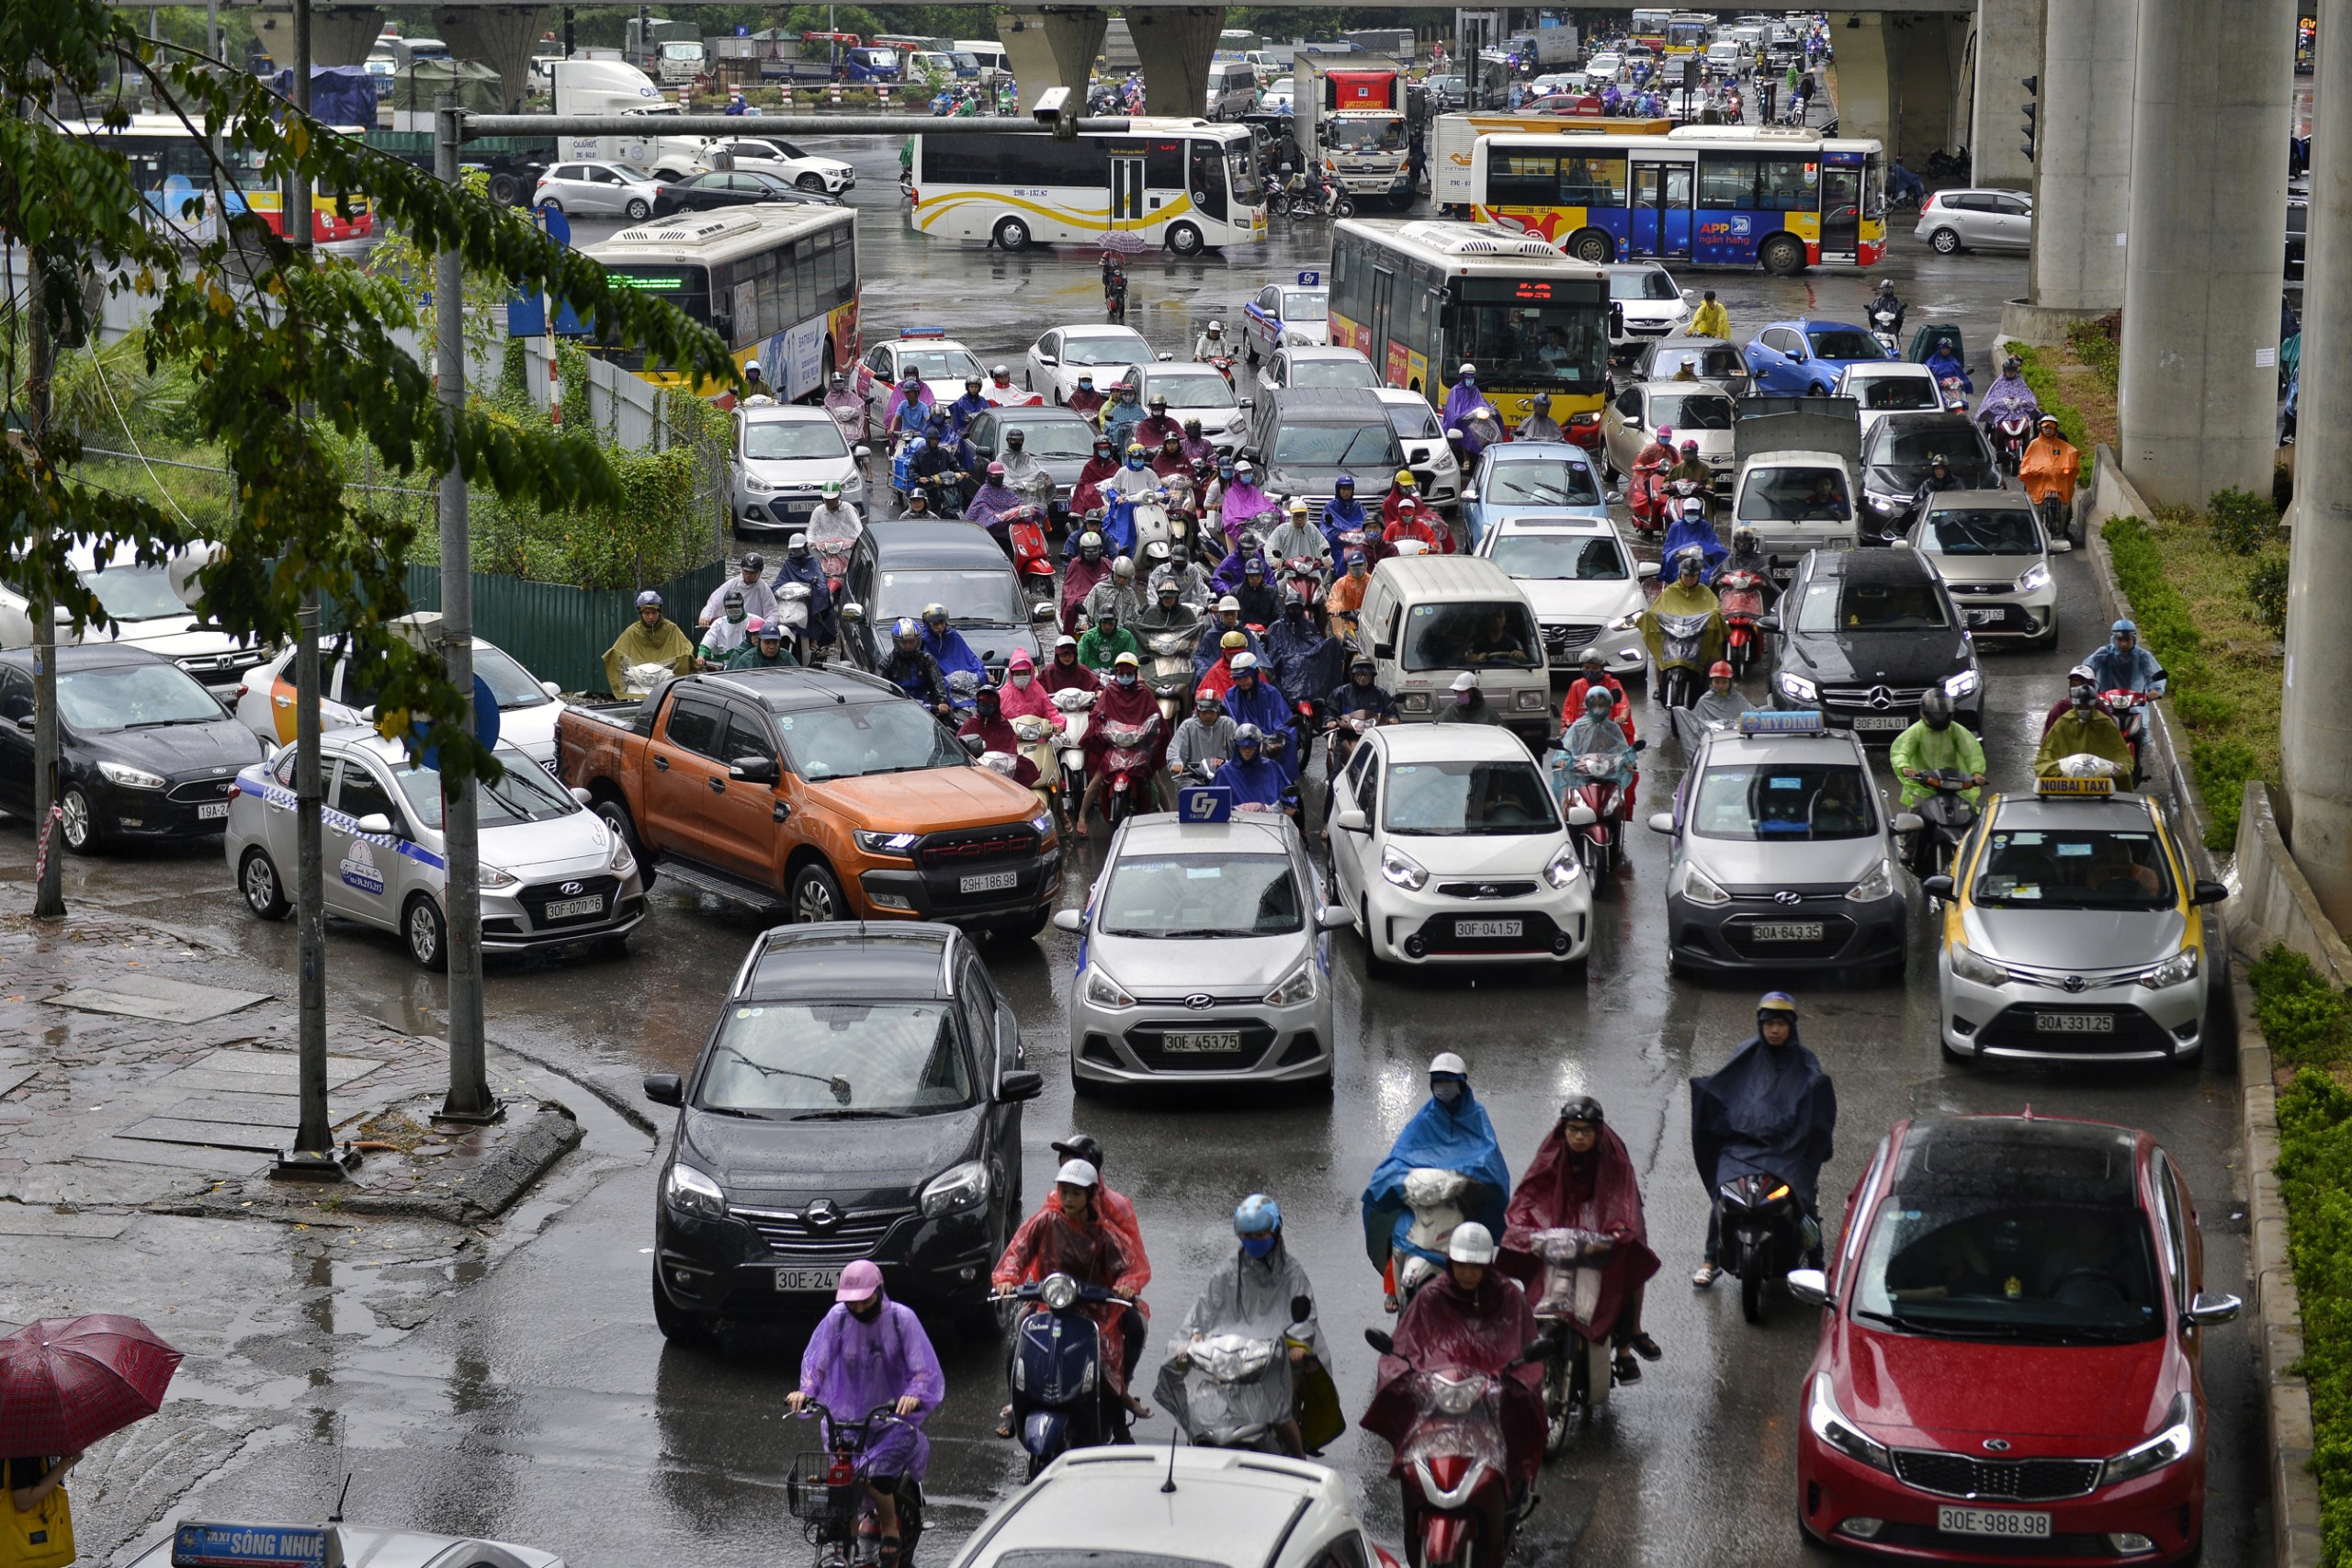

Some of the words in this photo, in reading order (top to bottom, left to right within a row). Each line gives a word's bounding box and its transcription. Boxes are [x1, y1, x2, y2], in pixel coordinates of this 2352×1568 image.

[1700, 222, 1730, 234] APP
[2041, 780, 2080, 792] NOIBAI
[2083, 780, 2109, 792] TAXI
[1191, 792, 1218, 819] G7
[962, 874, 1015, 892] 29H-186.98
[1457, 922, 1521, 935] 30F-041.57
[1755, 926, 1820, 939] 30A-643.35
[2038, 1016, 2111, 1031] 30A-331.25
[1166, 1035, 1238, 1049] 30E-453.75
[1941, 1509, 2047, 1534] 30E-988.98
[231, 1529, 278, 1556] SÔNG
[279, 1532, 325, 1562] NHUỆ
